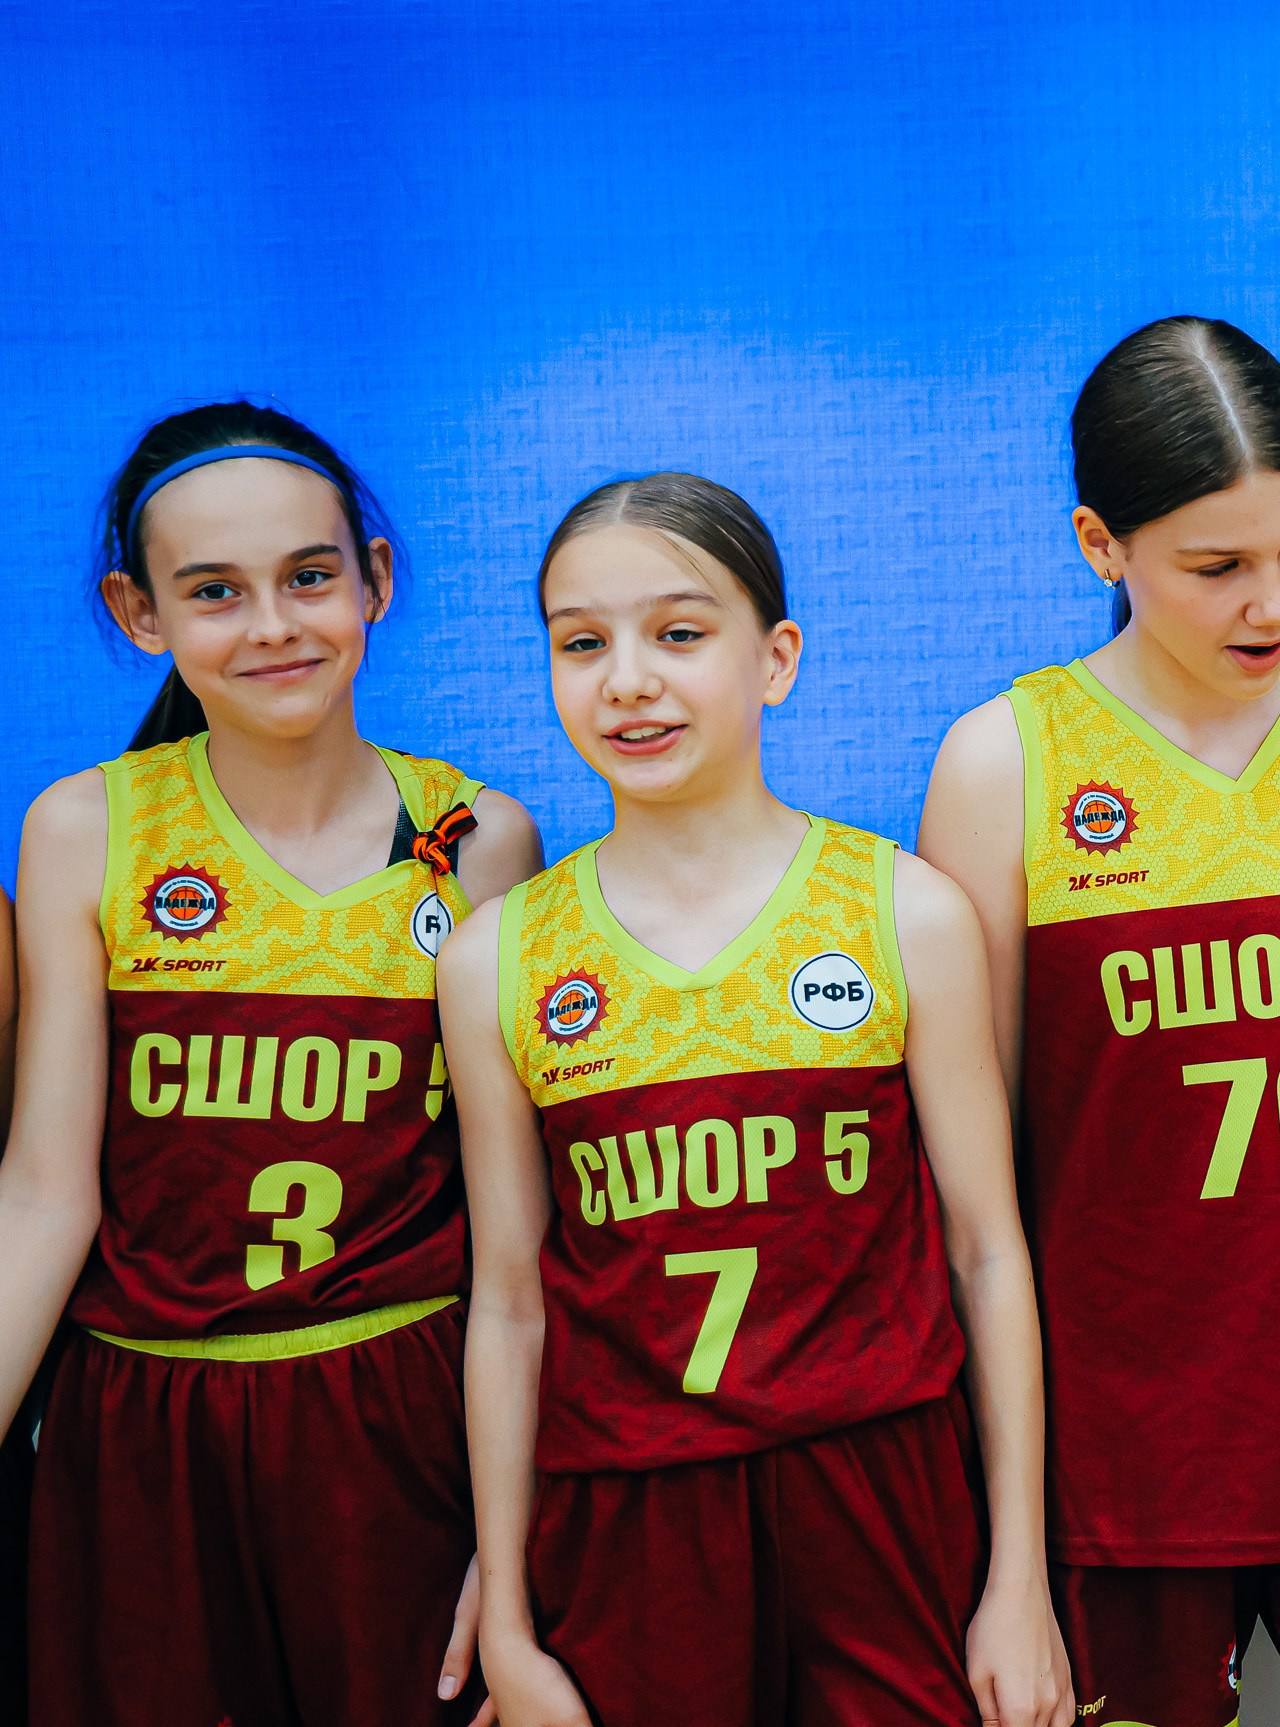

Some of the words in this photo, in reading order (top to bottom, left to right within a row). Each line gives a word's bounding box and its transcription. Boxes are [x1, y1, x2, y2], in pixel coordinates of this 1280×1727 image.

[1068, 873, 1093, 892] 2K
[1095, 870, 1150, 887] SPORT
[131, 957, 162, 973] 2K
[163, 960, 227, 972] SPORT
[803, 981, 865, 1003] РФБ
[131, 1033, 402, 1122] СШОР
[562, 1058, 615, 1080] SPORT
[569, 1116, 796, 1225] СШОР
[824, 1110, 869, 1194] 5
[246, 1161, 342, 1291] 3
[665, 1248, 758, 1393] 7
